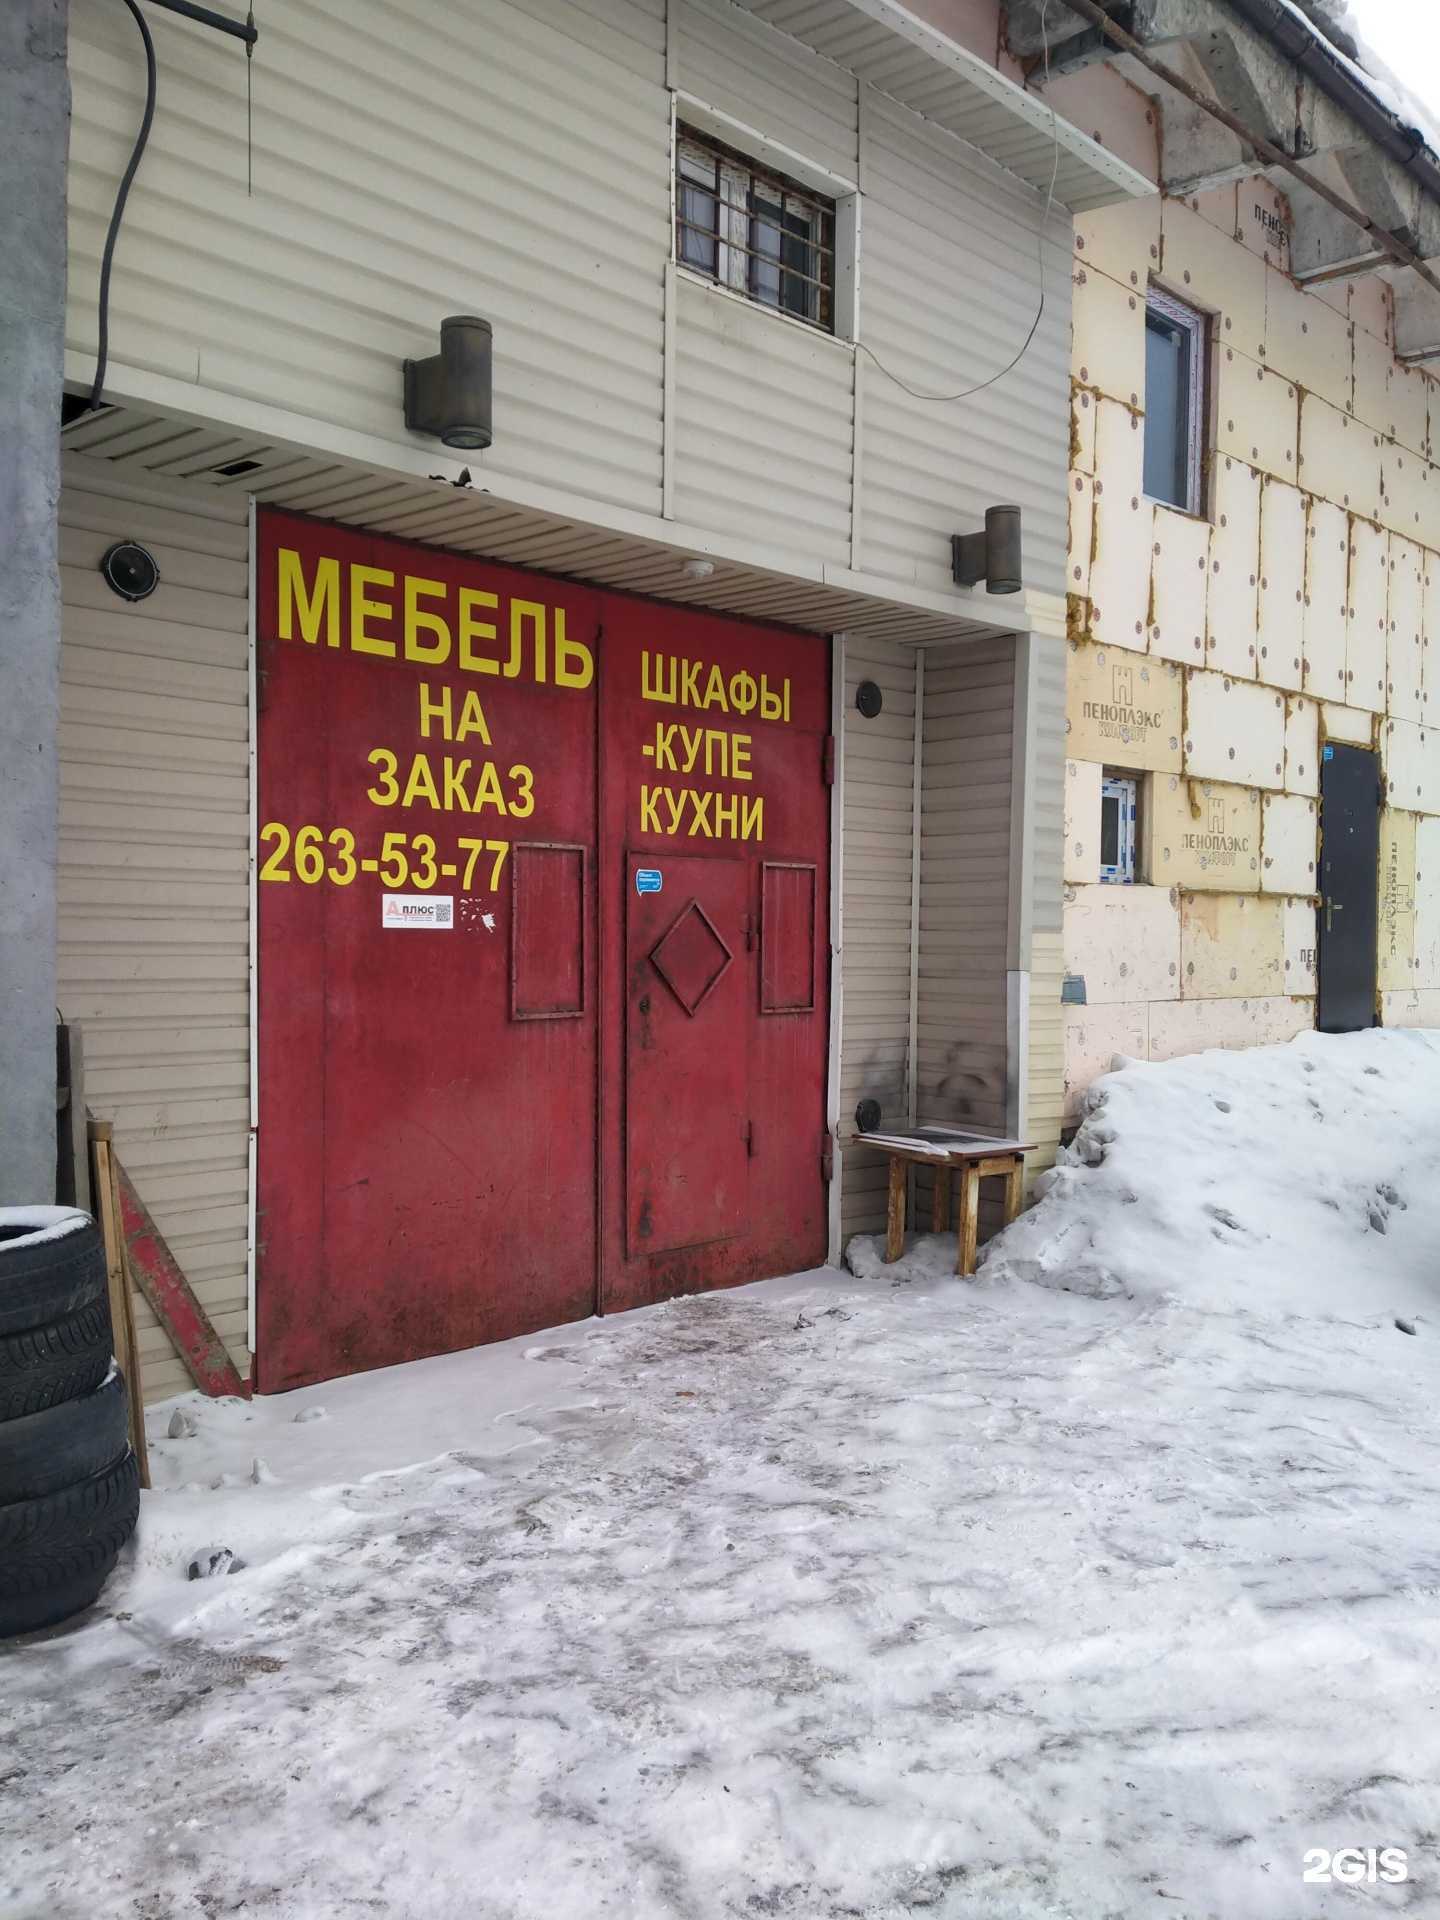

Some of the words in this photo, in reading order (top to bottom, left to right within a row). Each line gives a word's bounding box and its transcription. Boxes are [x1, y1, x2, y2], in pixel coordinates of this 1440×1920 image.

[278, 548, 594, 689] МЕБЕЛЬ
[419, 683, 492, 745] НА
[641, 651, 791, 722] ШКАФЫ
[1083, 701, 1161, 728] ПЕНОПЛЭКС
[367, 748, 535, 818] ЗАКАЗ
[642, 723, 753, 781] -КУПЕ
[640, 784, 764, 841] КУХНИ
[1182, 834, 1249, 852] ПЕНОПЛЭКС
[259, 822, 510, 892] 263-53-77
